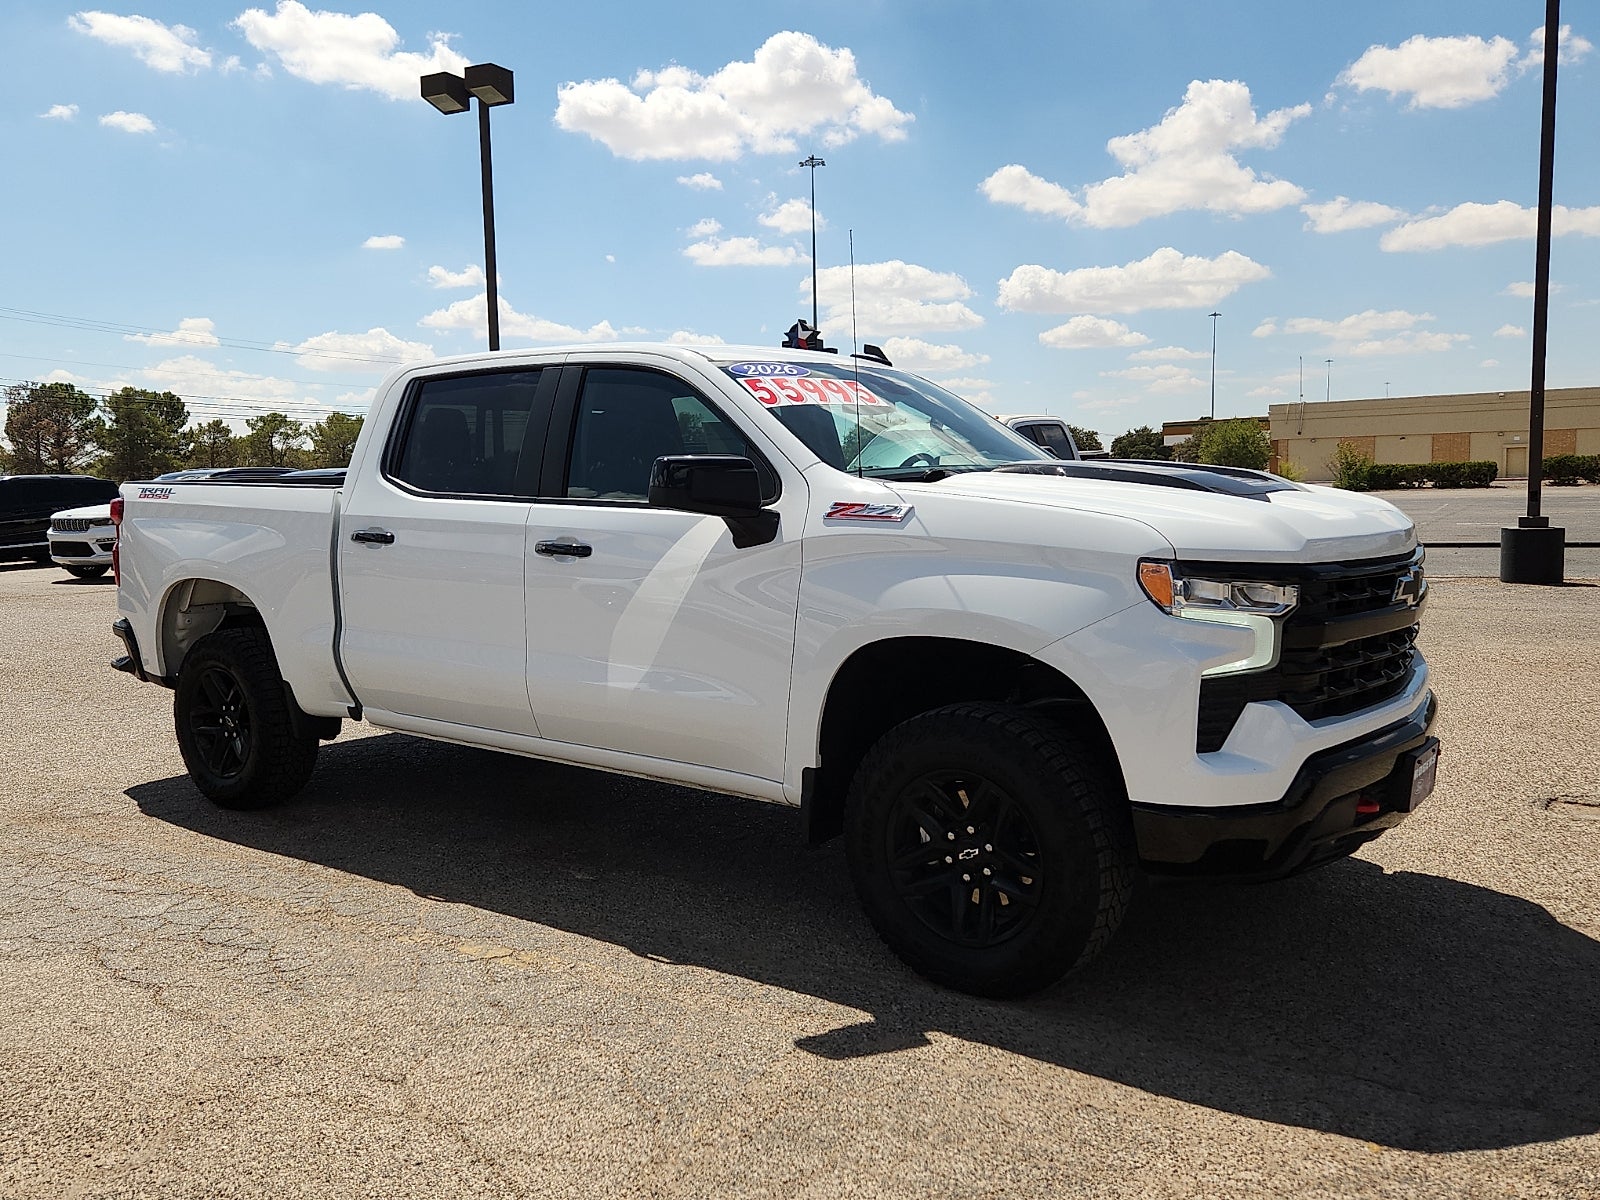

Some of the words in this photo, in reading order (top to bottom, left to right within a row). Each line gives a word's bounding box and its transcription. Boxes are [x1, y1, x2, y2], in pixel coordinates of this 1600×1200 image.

[743, 363, 799, 376] 2026
[743, 377, 880, 406] 55995
[137, 487, 176, 495] TRAIL
[823, 501, 912, 522] Z71
